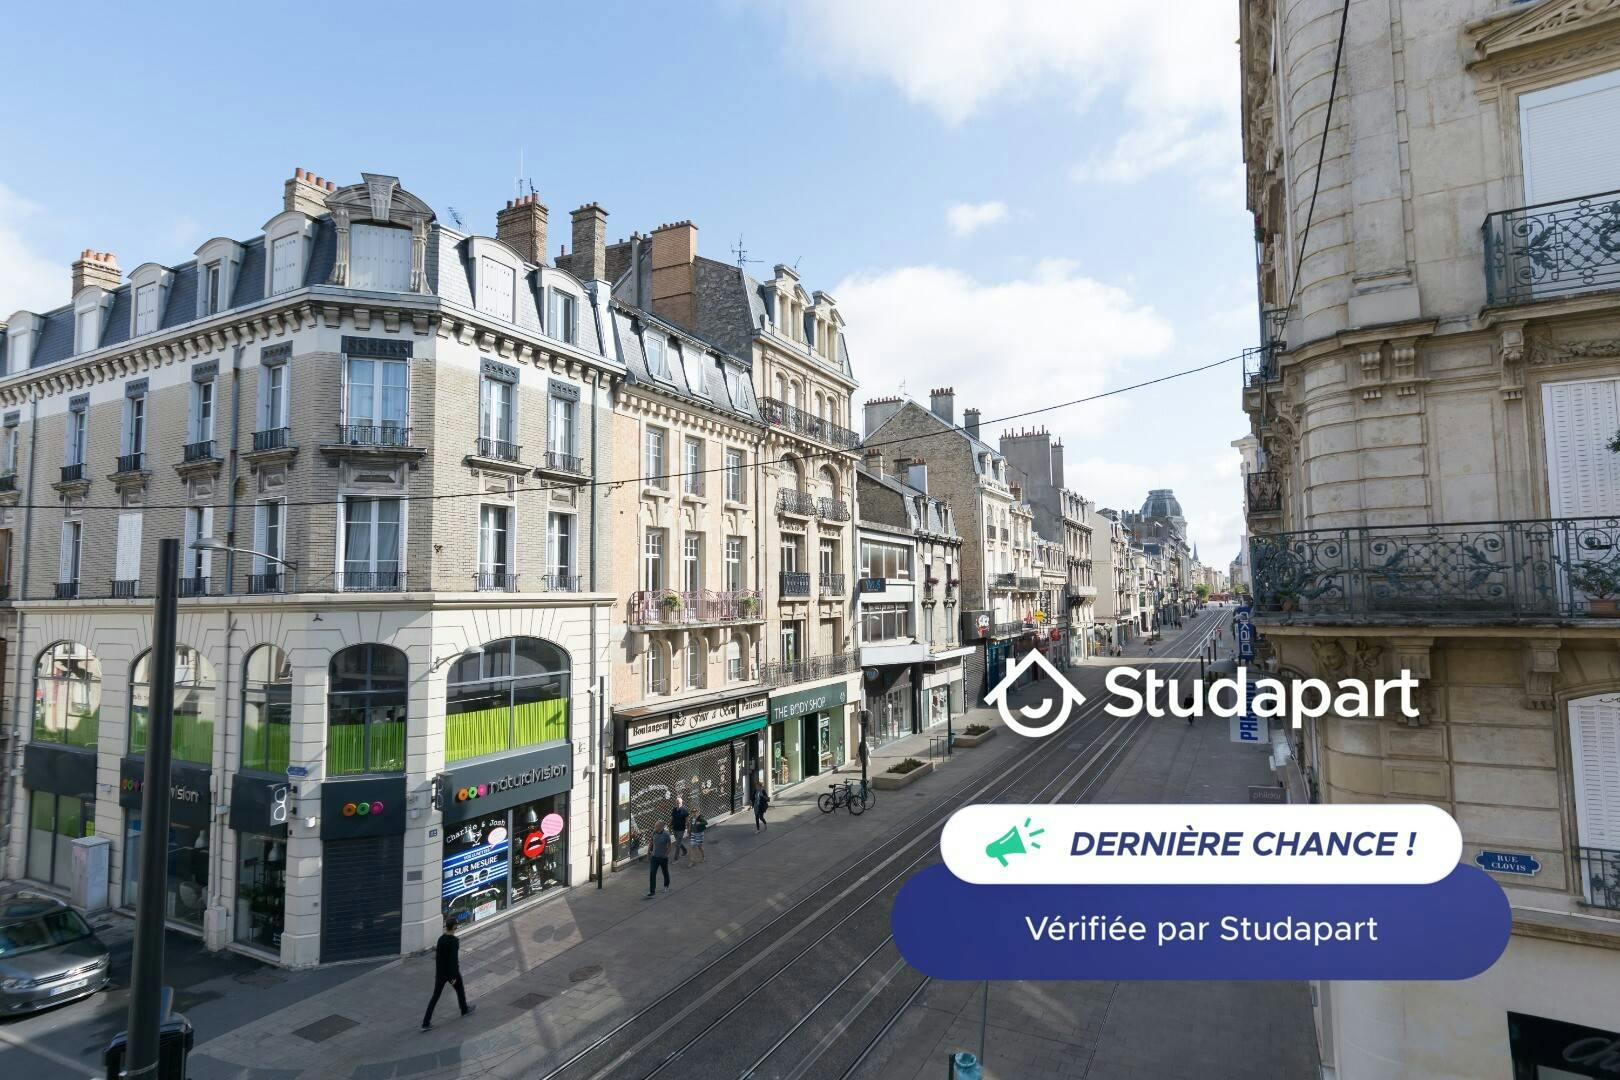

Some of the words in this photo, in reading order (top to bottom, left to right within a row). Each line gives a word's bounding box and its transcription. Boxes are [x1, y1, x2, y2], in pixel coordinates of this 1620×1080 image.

[774, 705, 788, 719] THE
[790, 701, 808, 715] BODY
[809, 696, 826, 711] SHOP
[487, 763, 568, 795] naturalvision
[454, 865, 470, 876] SUR
[470, 854, 499, 871] MESURE
[1491, 862, 1526, 872] CLOVIS
[1497, 855, 1519, 863] RUE
